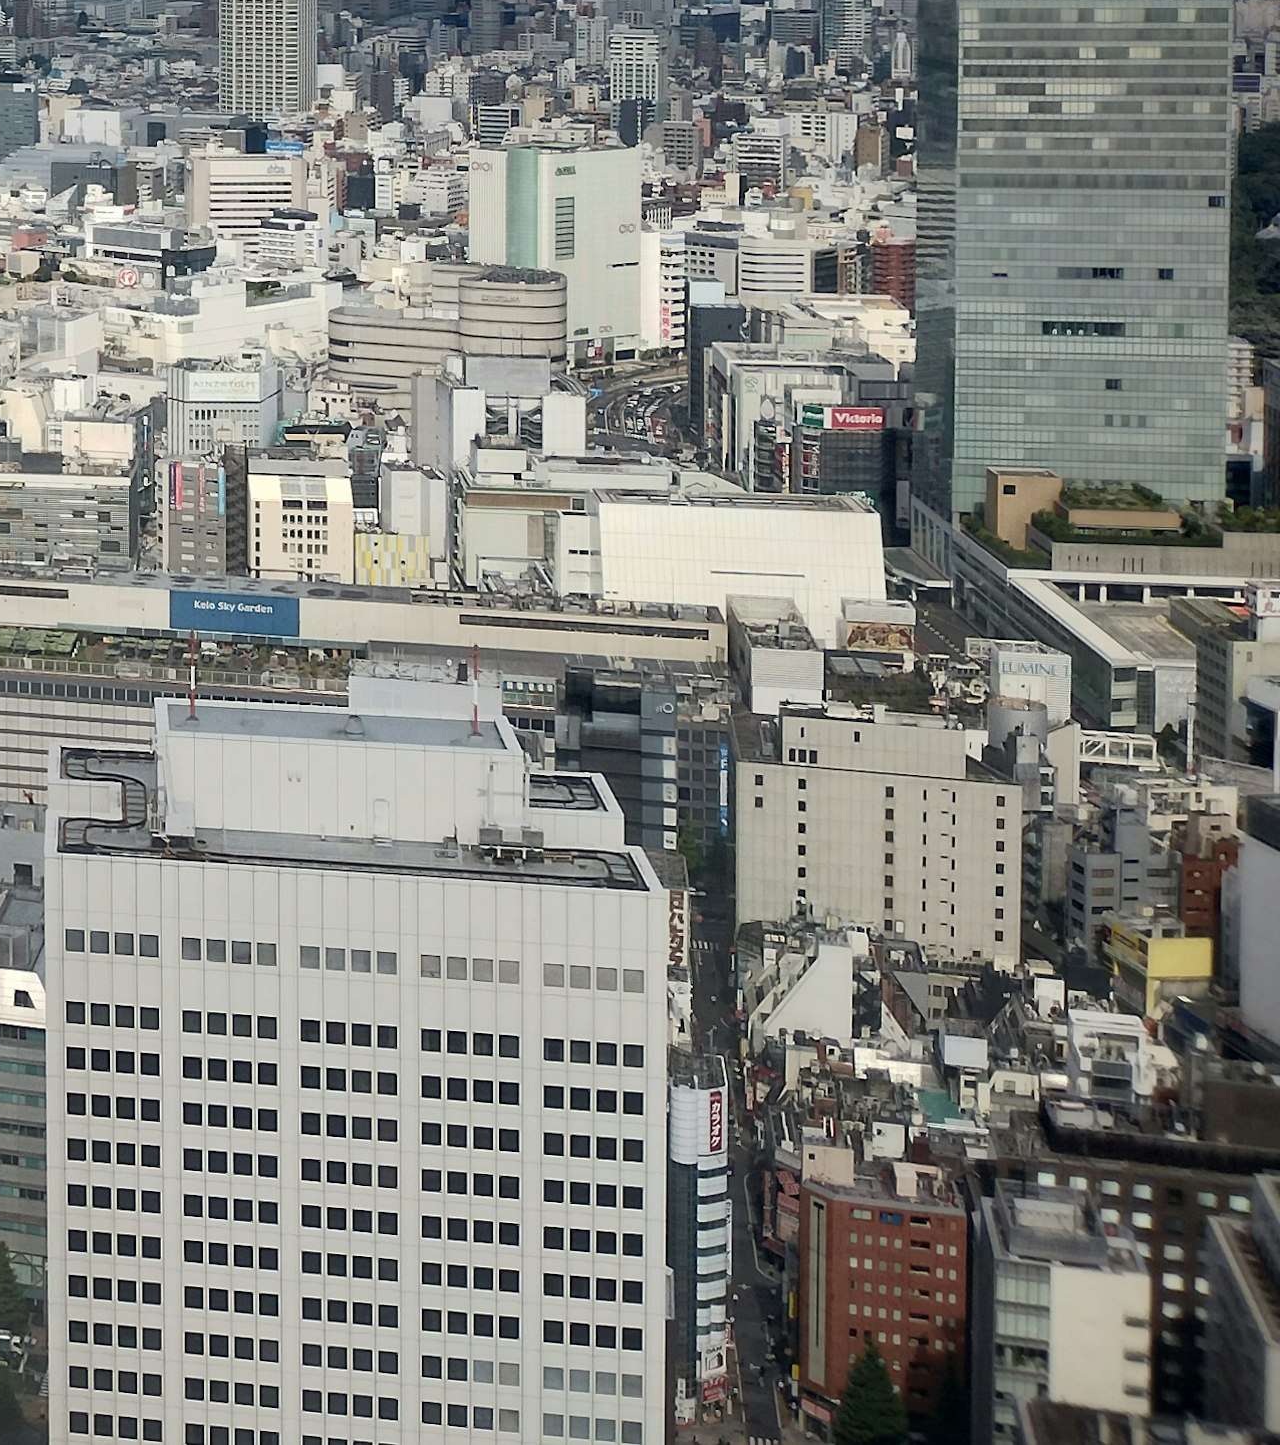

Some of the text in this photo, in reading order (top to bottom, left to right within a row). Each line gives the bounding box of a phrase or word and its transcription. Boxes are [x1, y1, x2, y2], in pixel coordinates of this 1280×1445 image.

[834, 412, 883, 424] Victoria
[193, 599, 273, 614] Keio Sky Garden
